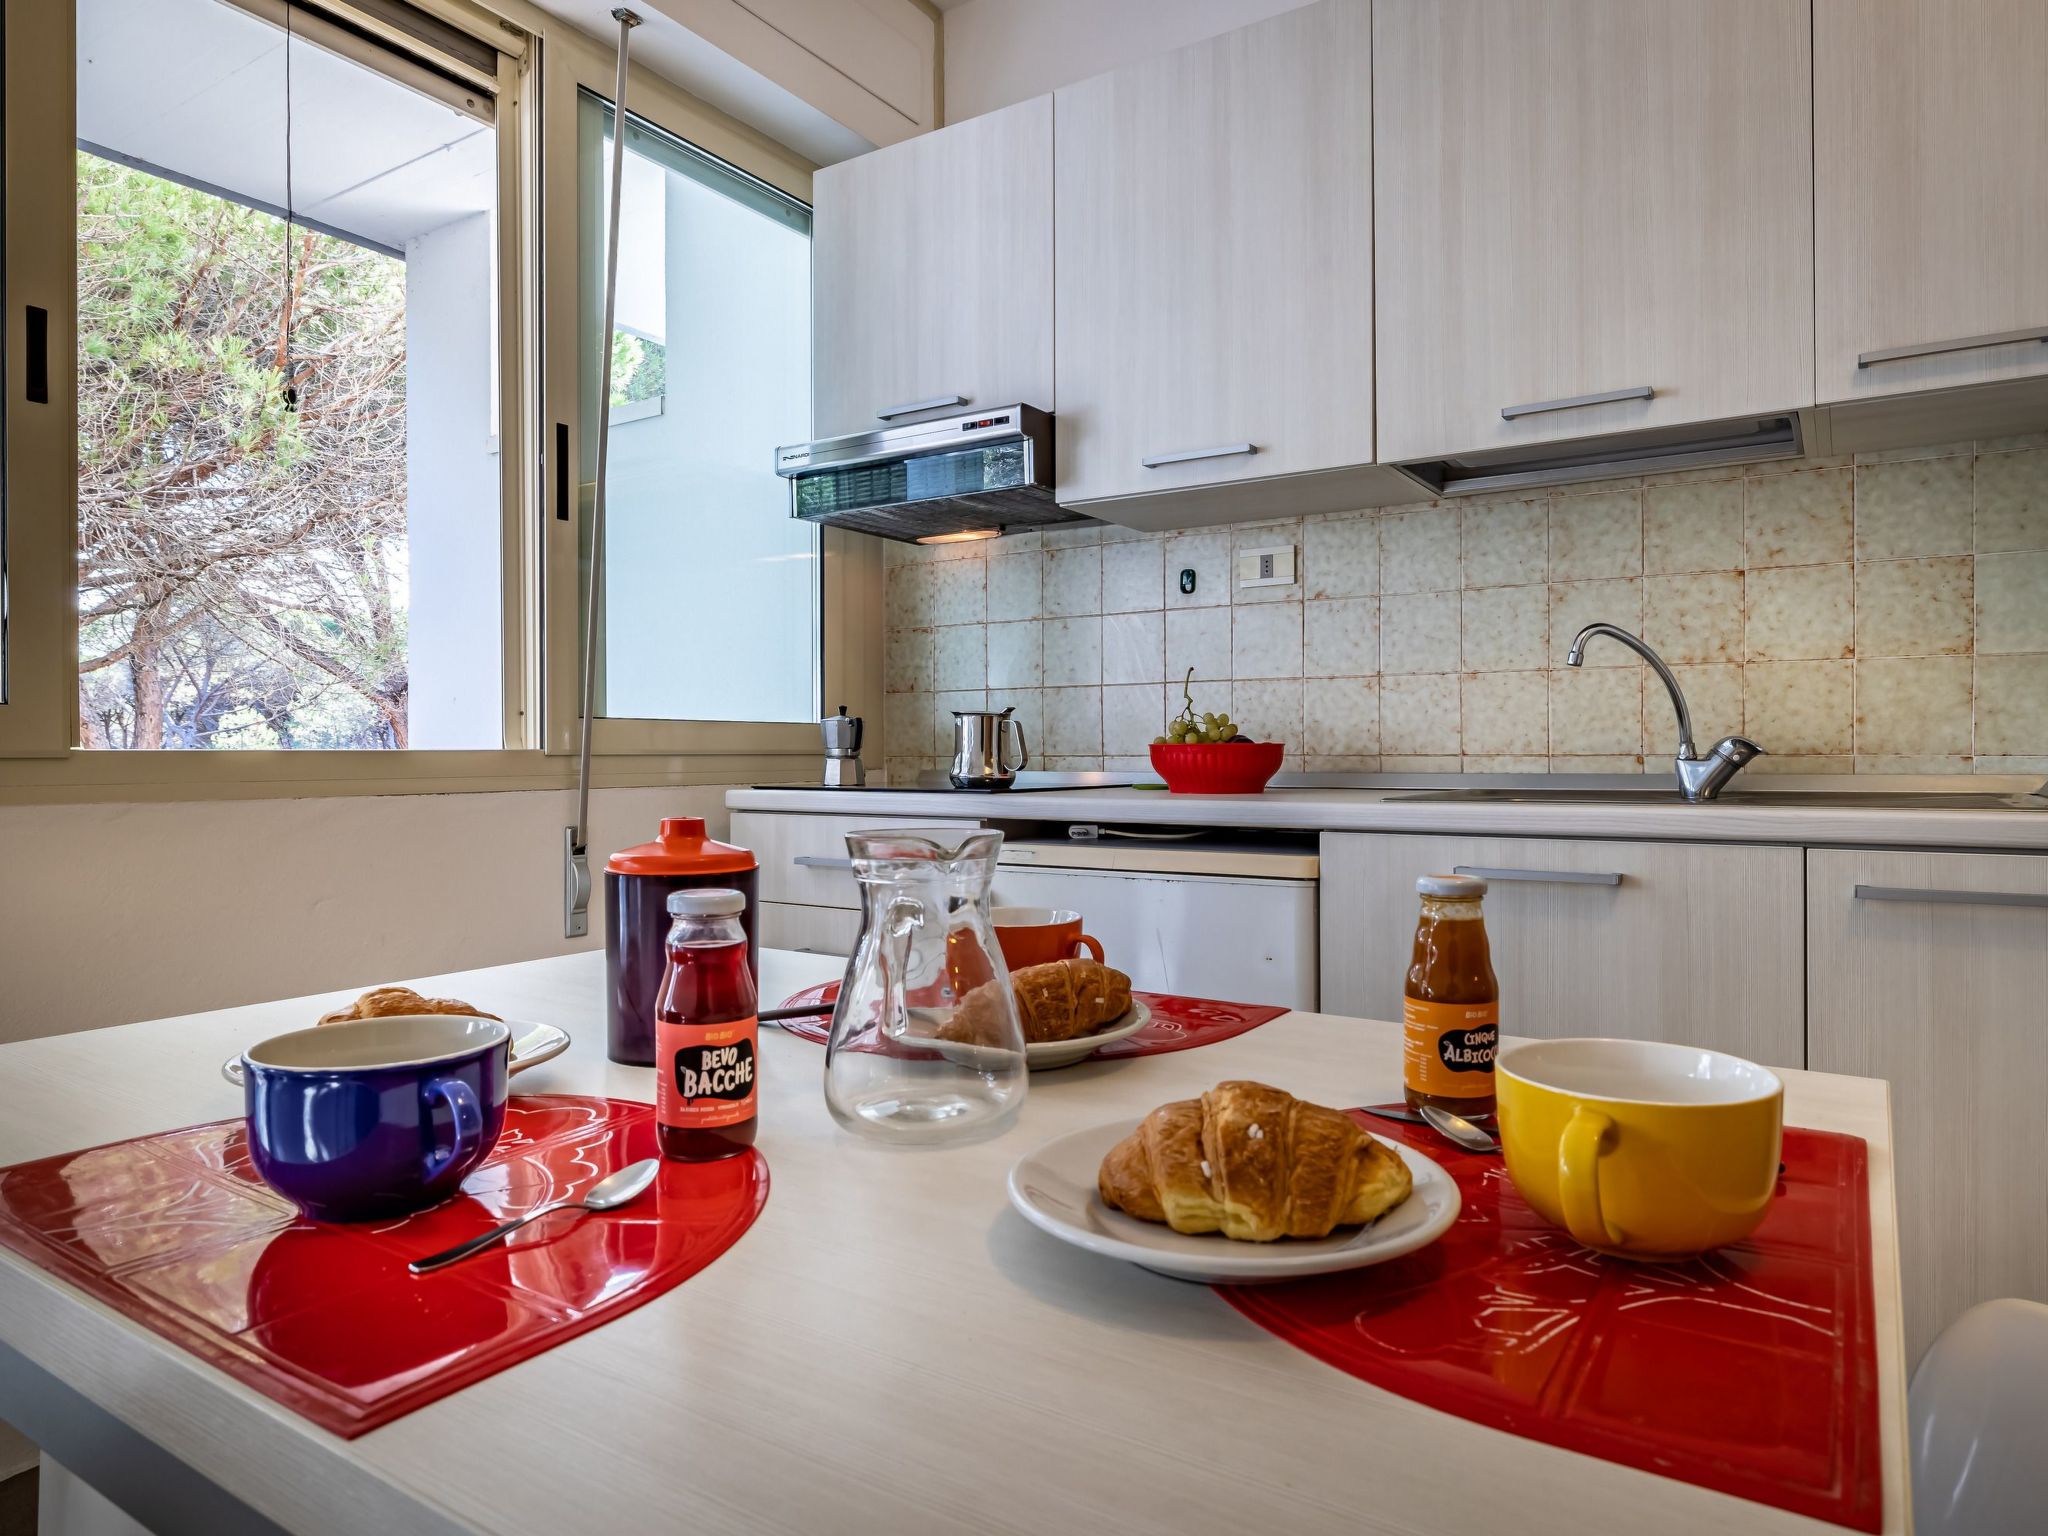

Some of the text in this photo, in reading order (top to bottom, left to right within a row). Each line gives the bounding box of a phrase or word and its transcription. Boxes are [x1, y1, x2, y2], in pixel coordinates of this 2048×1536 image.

[1464, 1030, 1495, 1046] CINQUE
[702, 1046, 737, 1070] BEVO
[684, 1056, 753, 1098] BACCHE
